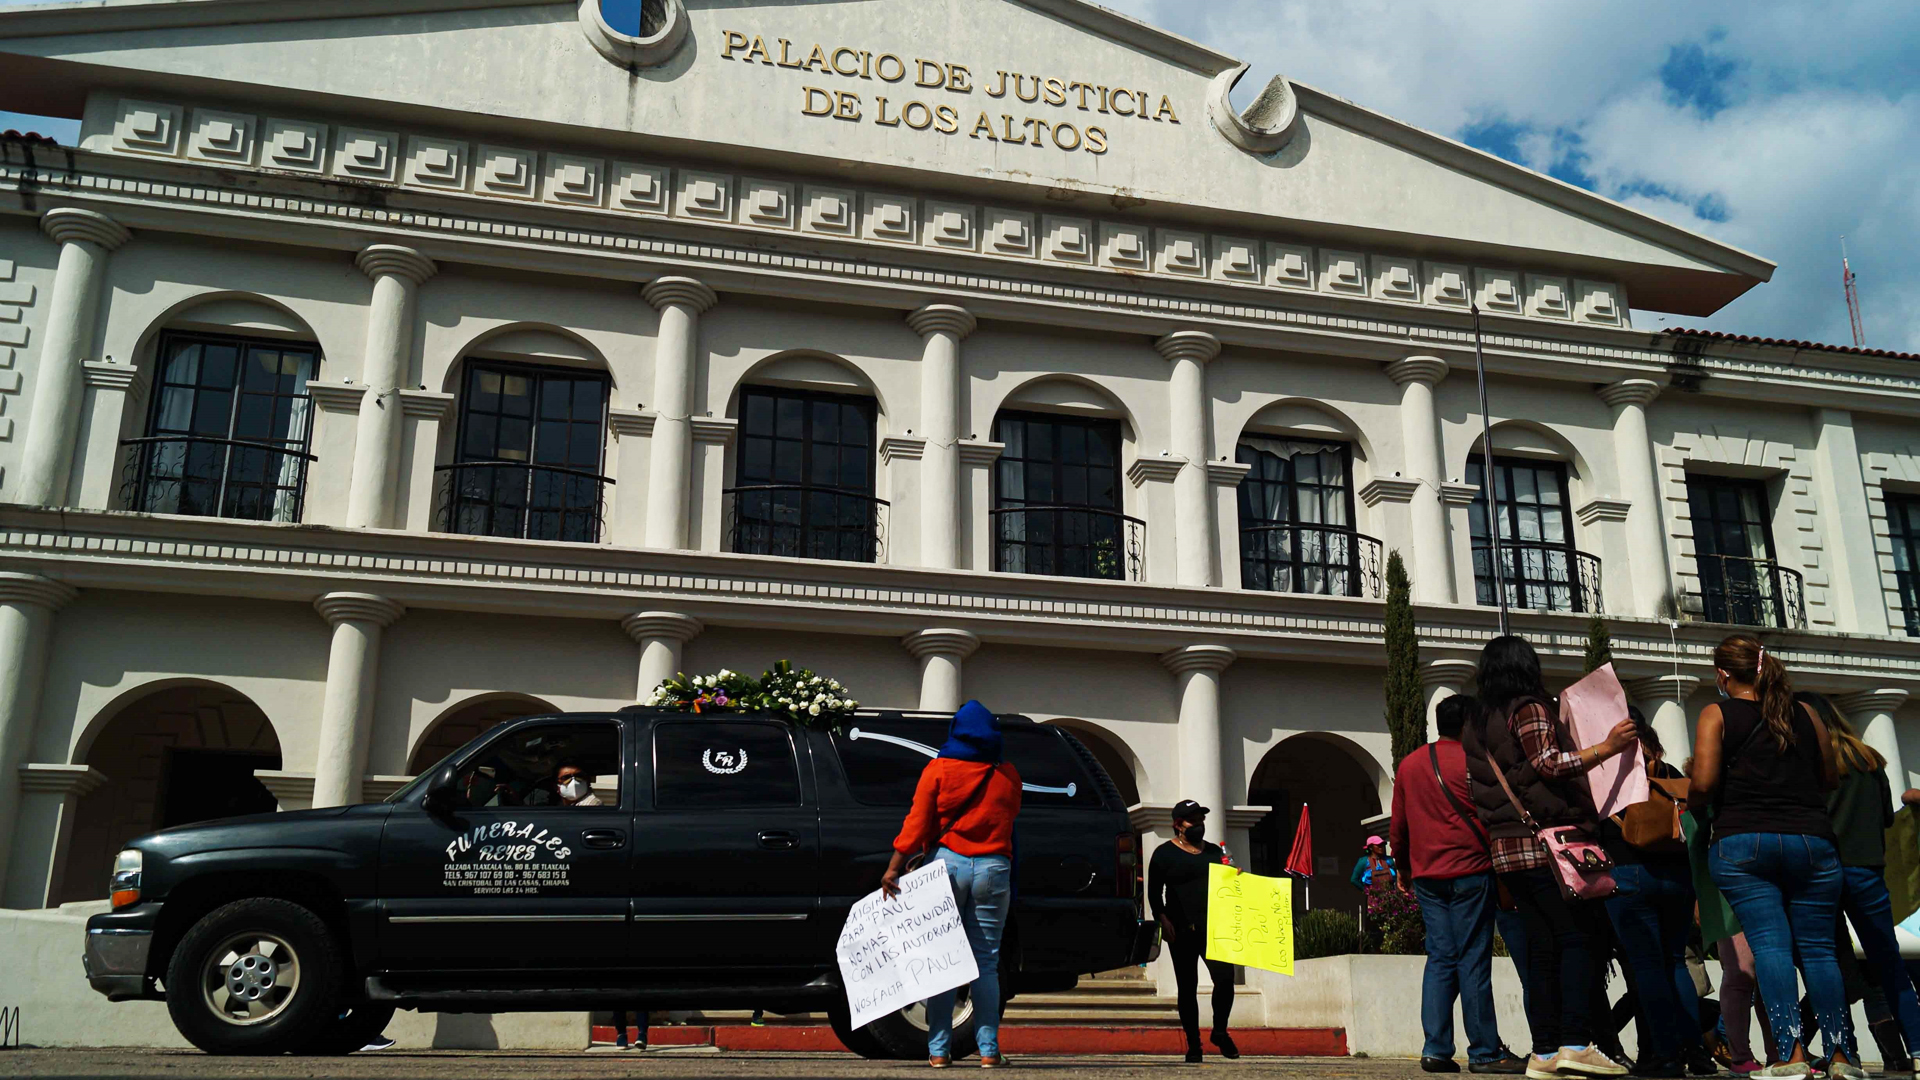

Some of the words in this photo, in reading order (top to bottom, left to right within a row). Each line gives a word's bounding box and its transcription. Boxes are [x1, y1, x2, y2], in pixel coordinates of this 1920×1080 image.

[720, 28, 906, 83] PALACIO
[914, 57, 973, 95] DE
[983, 69, 1181, 125] JUSTICIA
[801, 84, 862, 122] DE
[873, 95, 959, 134] LOS
[968, 110, 1109, 155] ALTOS
[446, 821, 572, 861] FUNERALES
[479, 844, 538, 861] REYES
[444, 871, 463, 879] TELS.
[464, 871, 479, 879] 967
[480, 871, 493, 879] 107
[493, 871, 503, 879] 69
[504, 871, 514, 879] 08
[522, 871, 537, 879] 967
[537, 871, 551, 879] 683
[552, 871, 560, 879] 15
[472, 863, 503, 871] TLAXCALA
[532, 863, 540, 871] DE
[541, 863, 570, 871] TLAXCALA
[905, 865, 948, 894] JUSTICIA
[1217, 879, 1244, 899] Para
[841, 923, 865, 949] PARA
[1213, 904, 1244, 953] Justicia
[851, 963, 874, 983] CON
[877, 946, 900, 969] LAS
